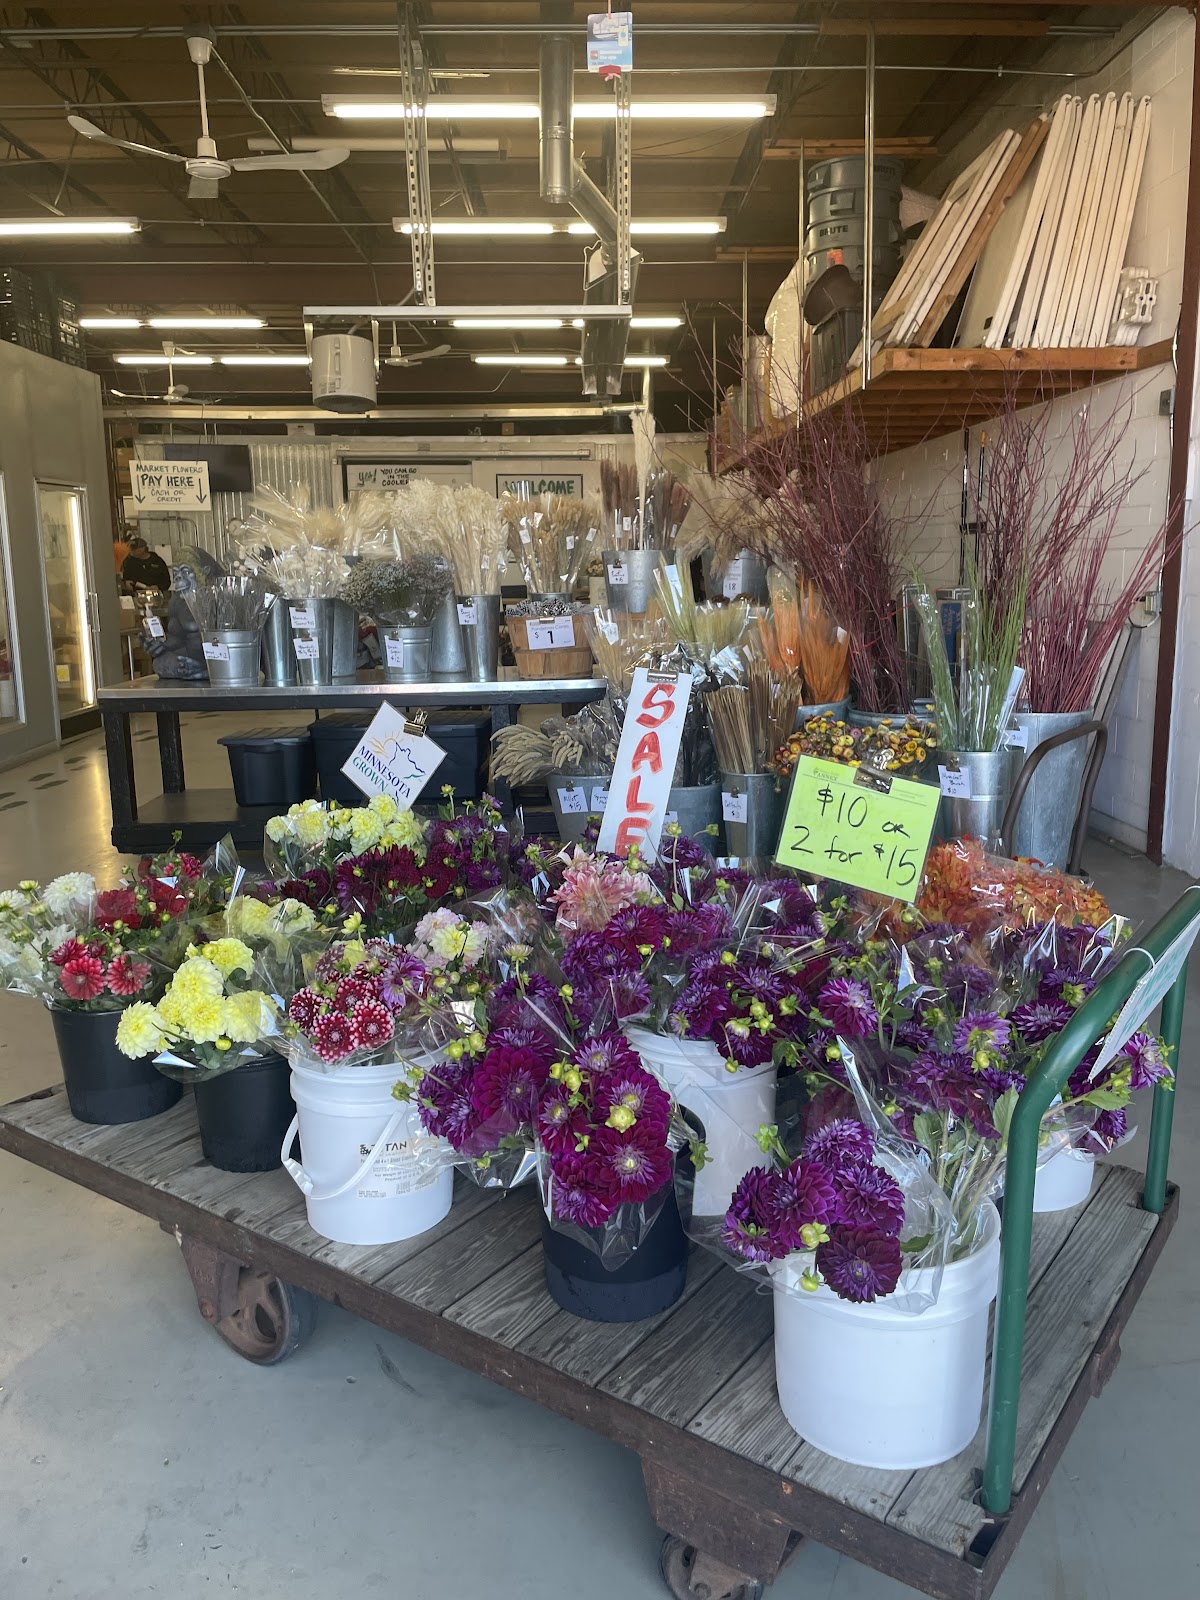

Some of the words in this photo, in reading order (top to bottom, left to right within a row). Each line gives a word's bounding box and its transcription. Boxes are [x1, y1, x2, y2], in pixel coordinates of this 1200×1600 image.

[820, 225, 849, 236] BRUTE
[136, 464, 169, 473] MARKET
[173, 465, 203, 474] FLOWERS
[141, 473, 162, 487] PAY
[166, 476, 194, 487] HERE
[357, 468, 377, 486] yes!
[352, 756, 388, 792] GROWN
[358, 745, 411, 798] MINNESOTA
[614, 683, 676, 857] SALE
[816, 783, 867, 827] $10
[790, 825, 814, 854] 2
[824, 835, 863, 864] for
[873, 843, 919, 886] $15
